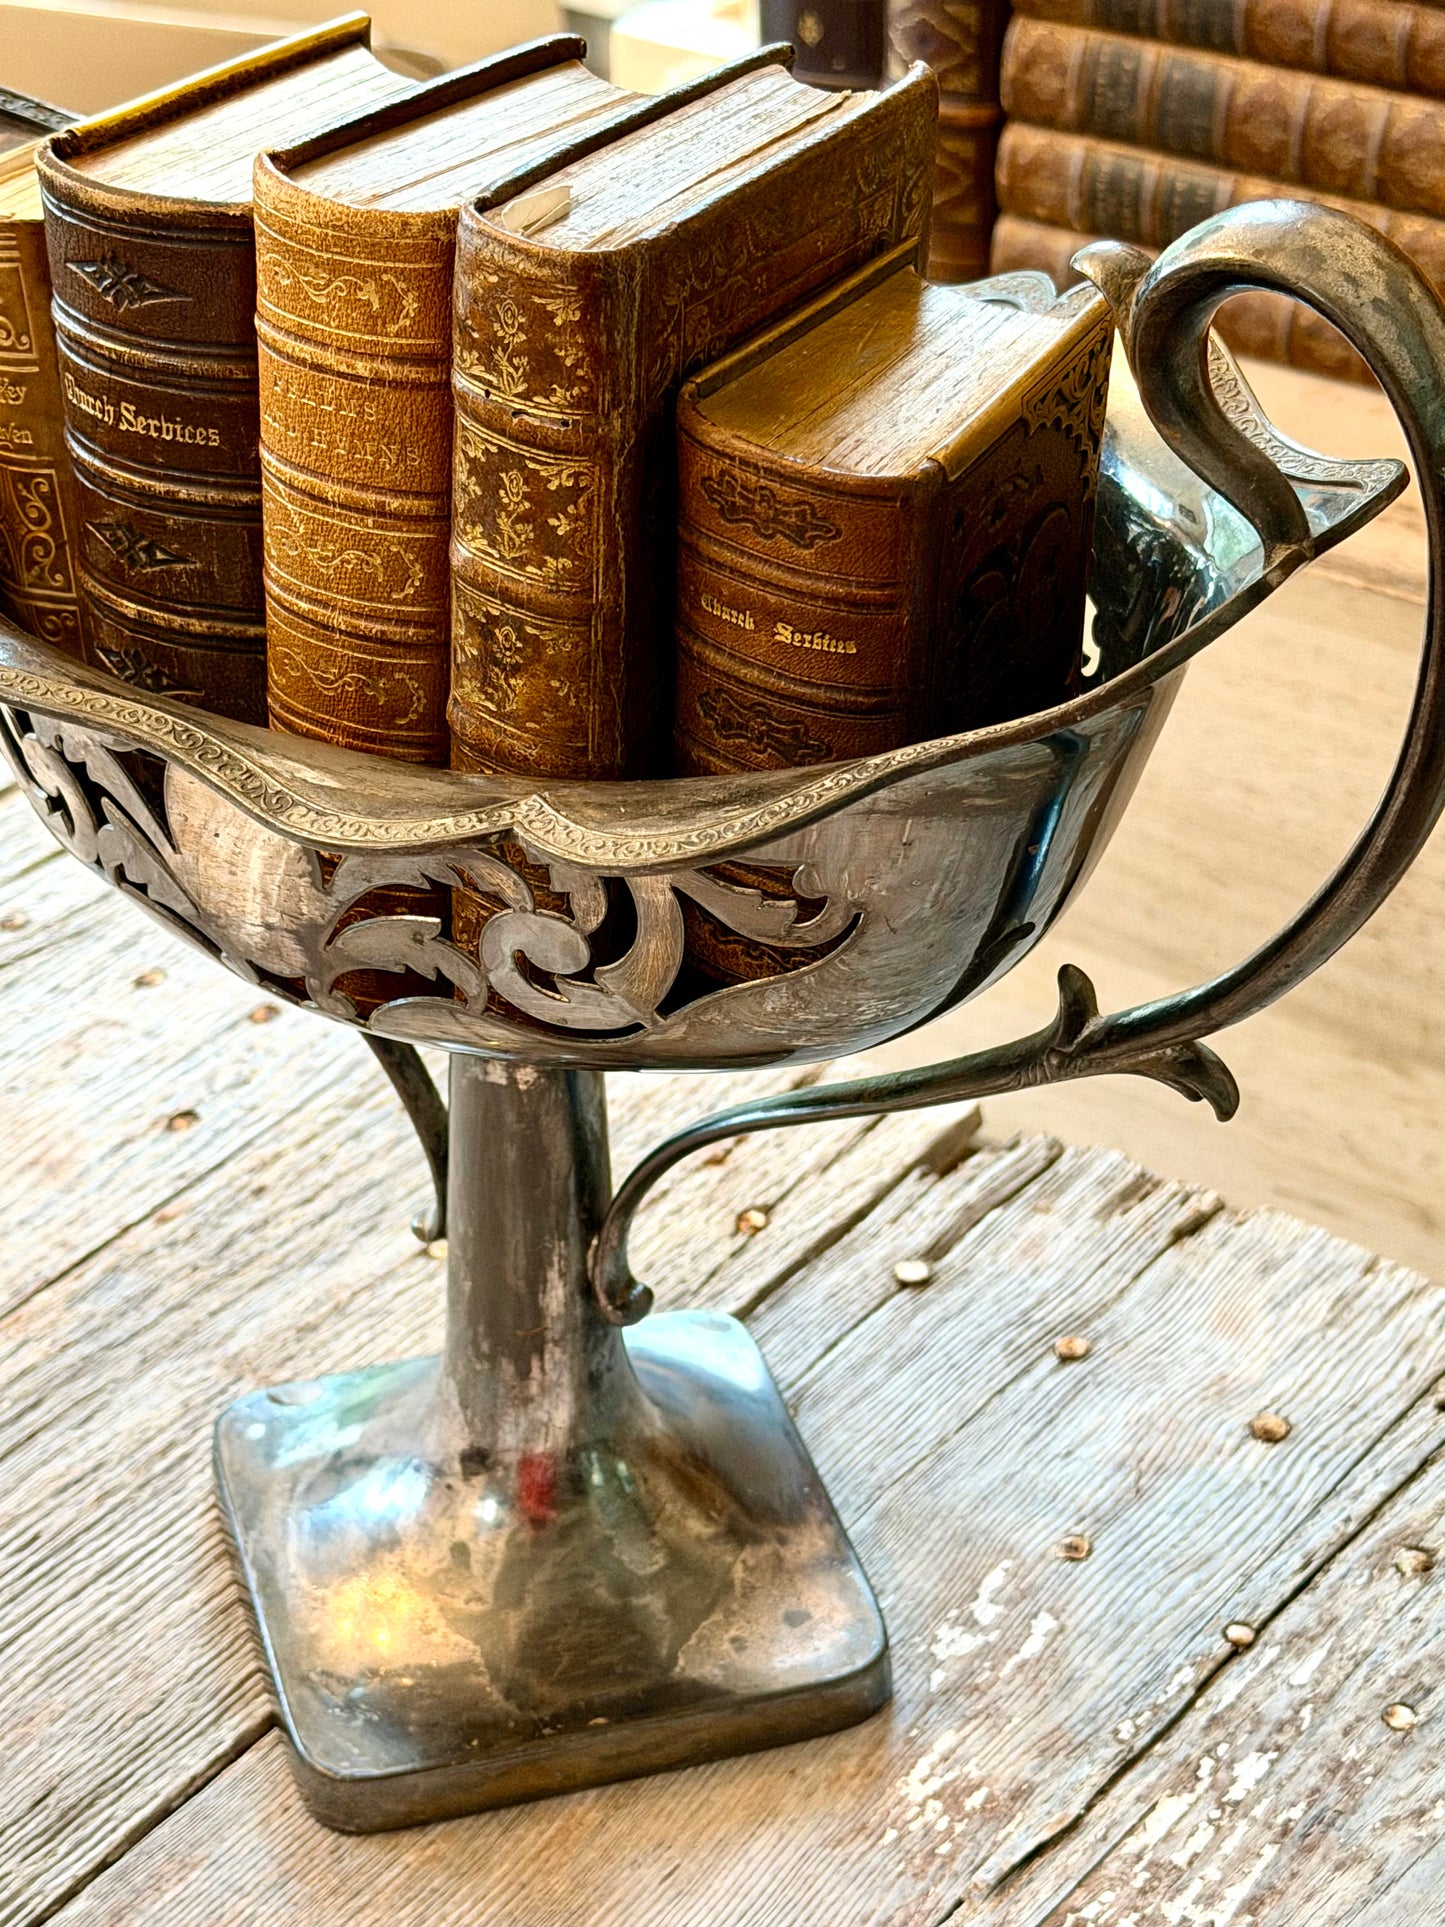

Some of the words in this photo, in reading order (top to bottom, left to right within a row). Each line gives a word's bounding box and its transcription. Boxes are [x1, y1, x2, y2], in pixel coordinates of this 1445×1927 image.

[64, 371, 115, 426] Church
[119, 401, 221, 447] Services
[701, 593, 755, 630] Church
[773, 622, 858, 654] Services
